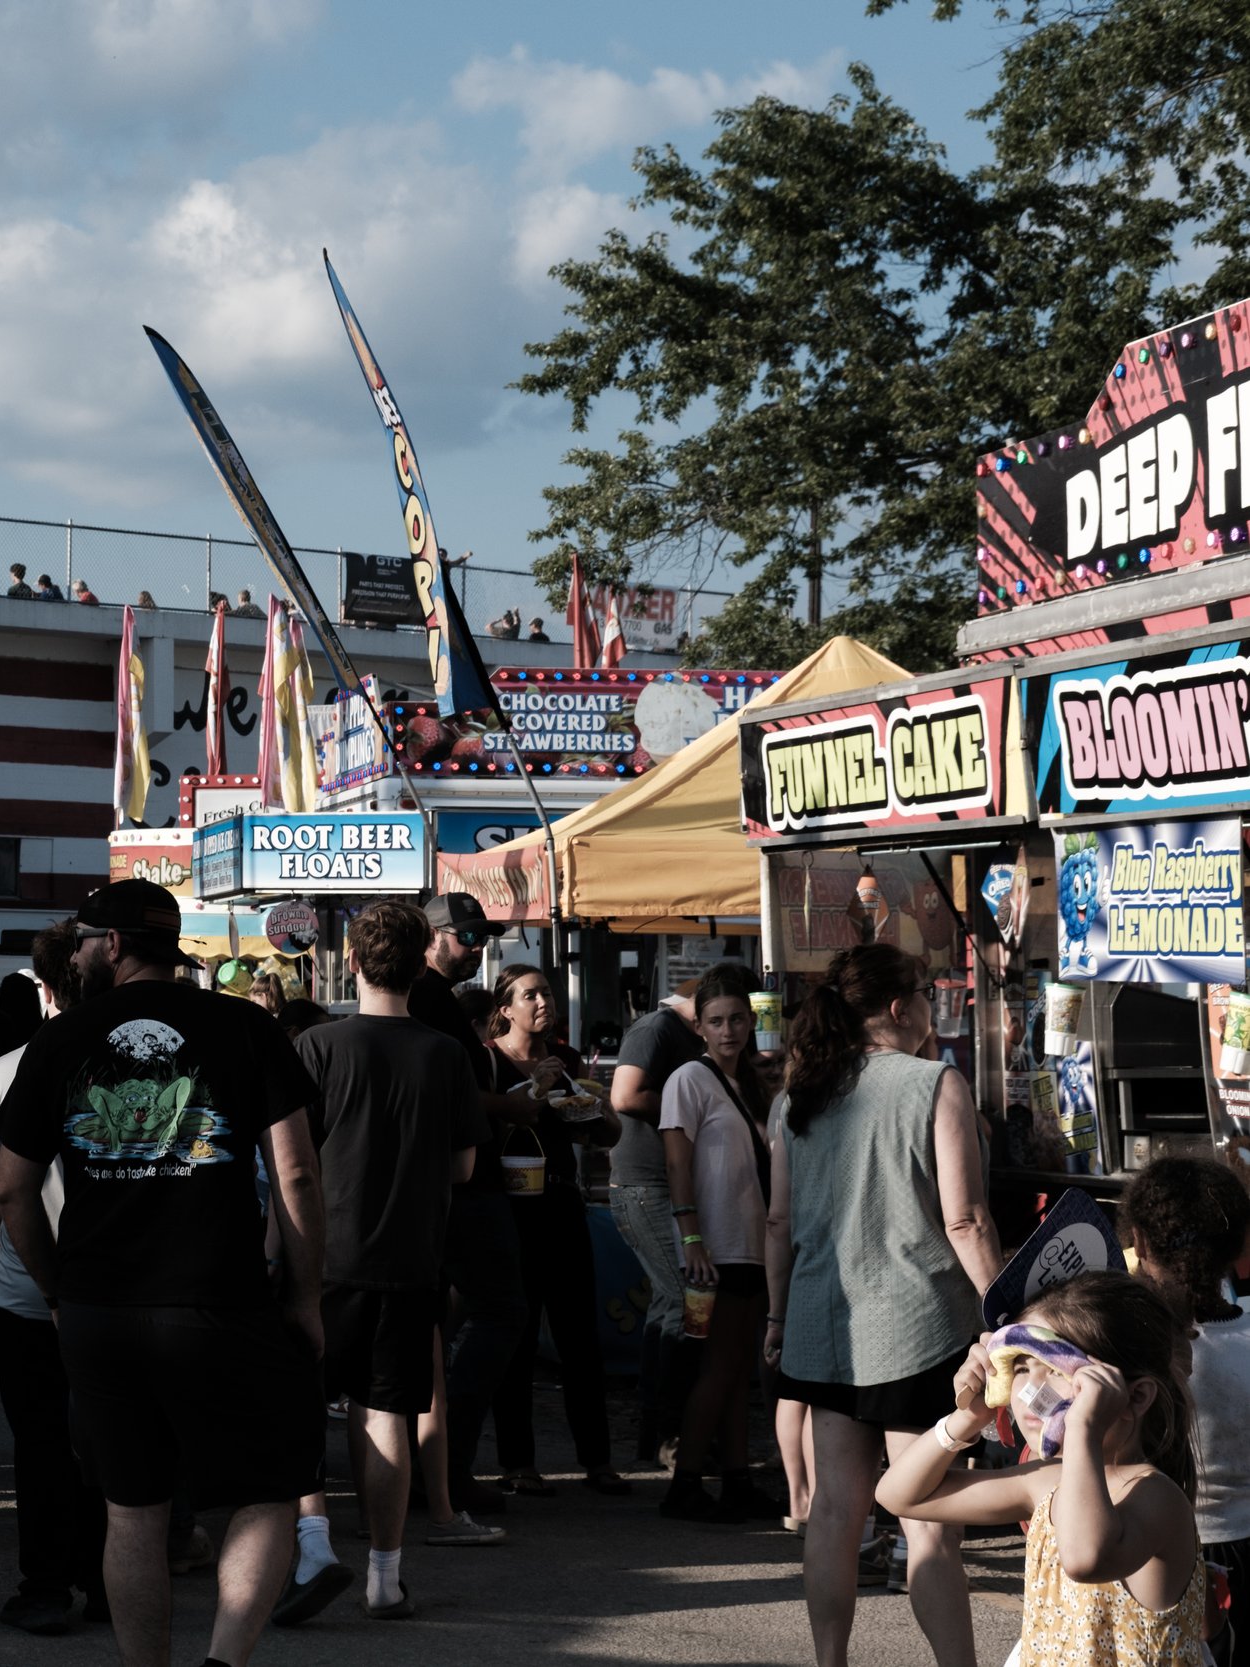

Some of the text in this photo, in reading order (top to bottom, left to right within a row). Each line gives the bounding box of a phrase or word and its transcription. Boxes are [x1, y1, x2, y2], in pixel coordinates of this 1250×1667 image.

[1066, 413, 1194, 560] DEEP
[376, 556, 403, 568] GTC
[654, 622, 672, 634] GAS
[500, 694, 620, 711] CHOCOLATE
[724, 686, 765, 709] HA
[512, 713, 606, 731] COVERED
[335, 728, 375, 777] DUMPLINGS
[768, 714, 987, 815] FUNNEL CAKE
[203, 804, 244, 824] Fresh
[252, 824, 412, 850] ROOT BEER
[280, 853, 382, 879] FLOATS
[1112, 844, 1241, 901] Blue Raspberry
[1109, 907, 1243, 952] LEMONADE
[115, 1166, 126, 1179] do
